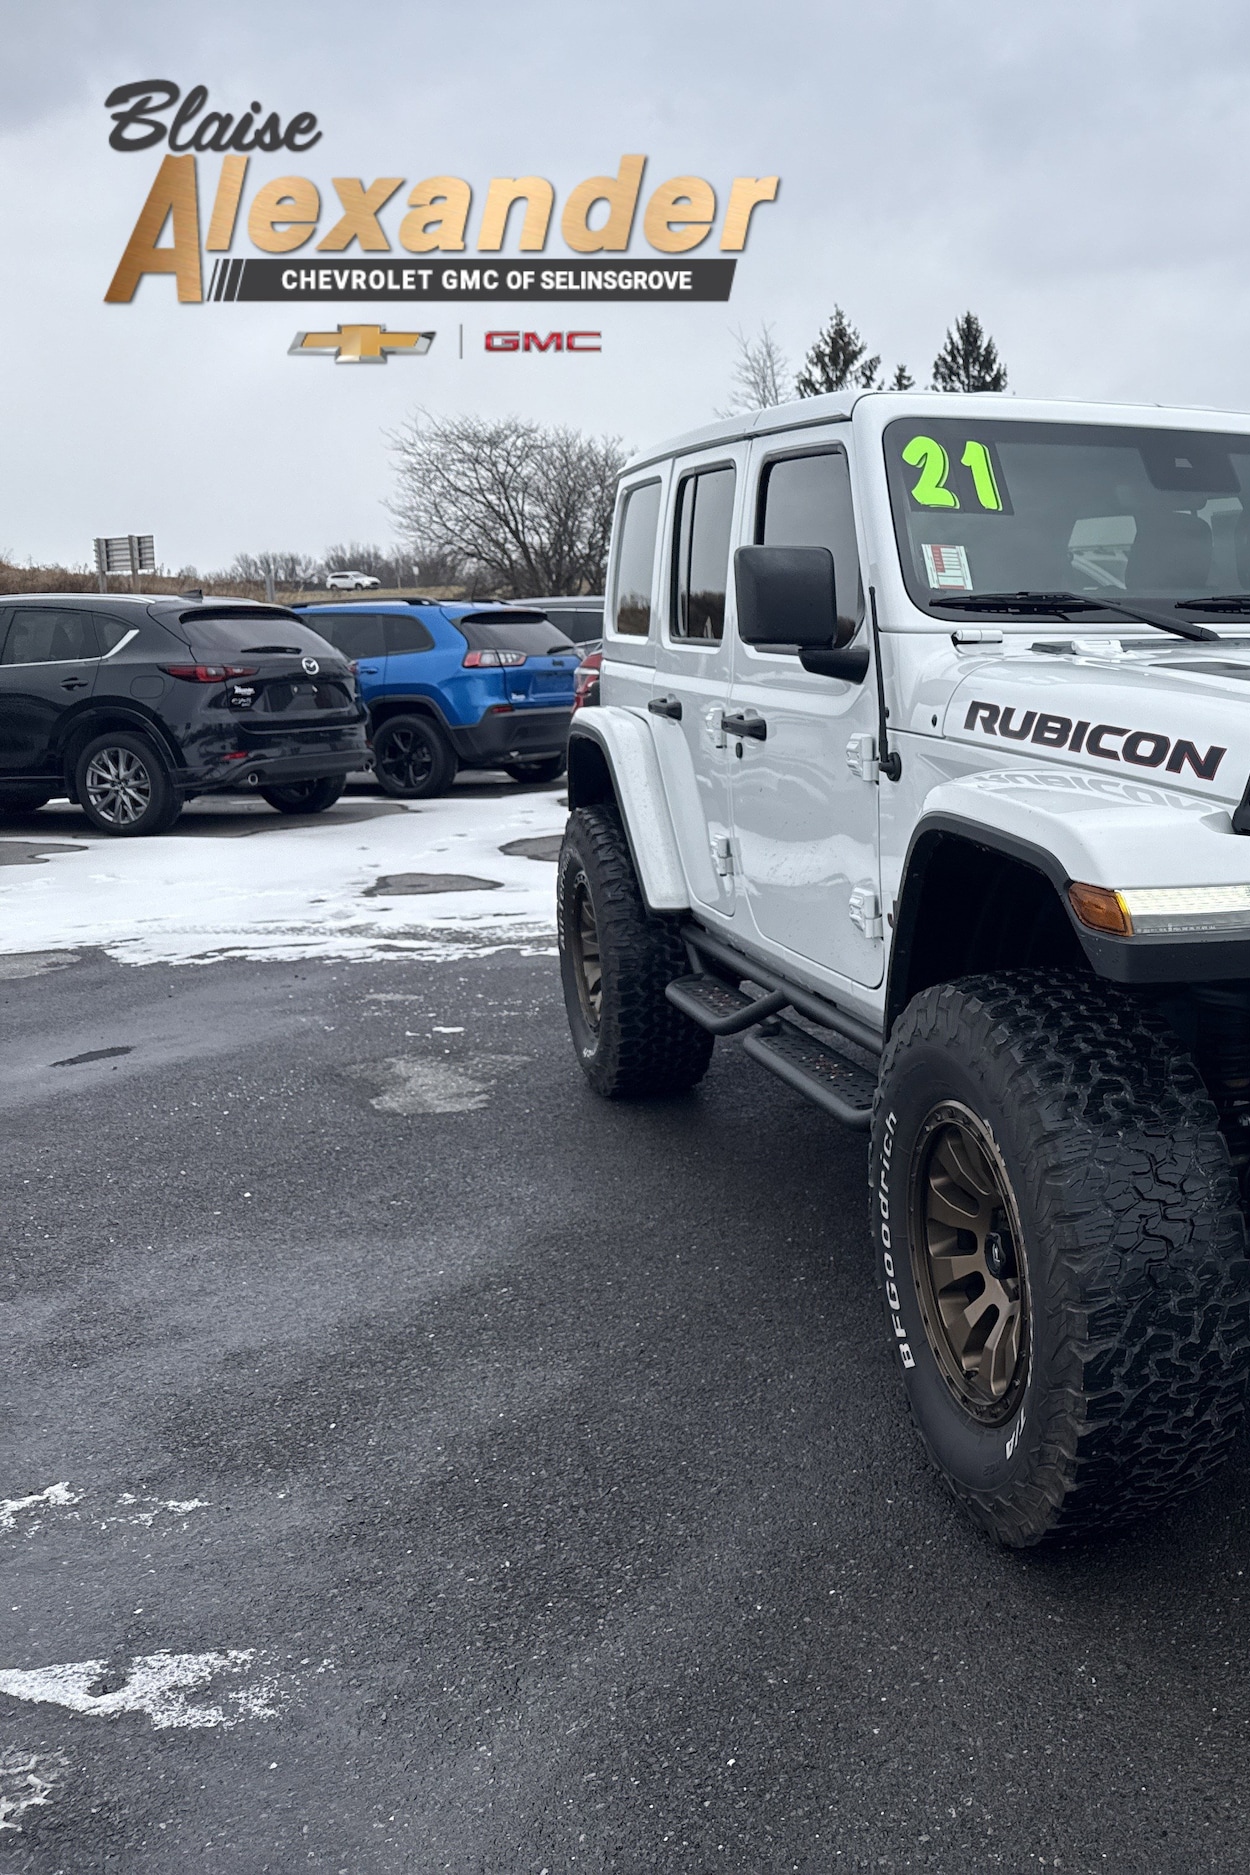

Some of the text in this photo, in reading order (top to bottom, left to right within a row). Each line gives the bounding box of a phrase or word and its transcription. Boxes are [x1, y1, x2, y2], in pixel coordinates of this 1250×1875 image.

[902, 435, 1002, 511] 21
[963, 700, 1228, 781] RUBICON
[877, 1111, 917, 1369] BFGoodrich
